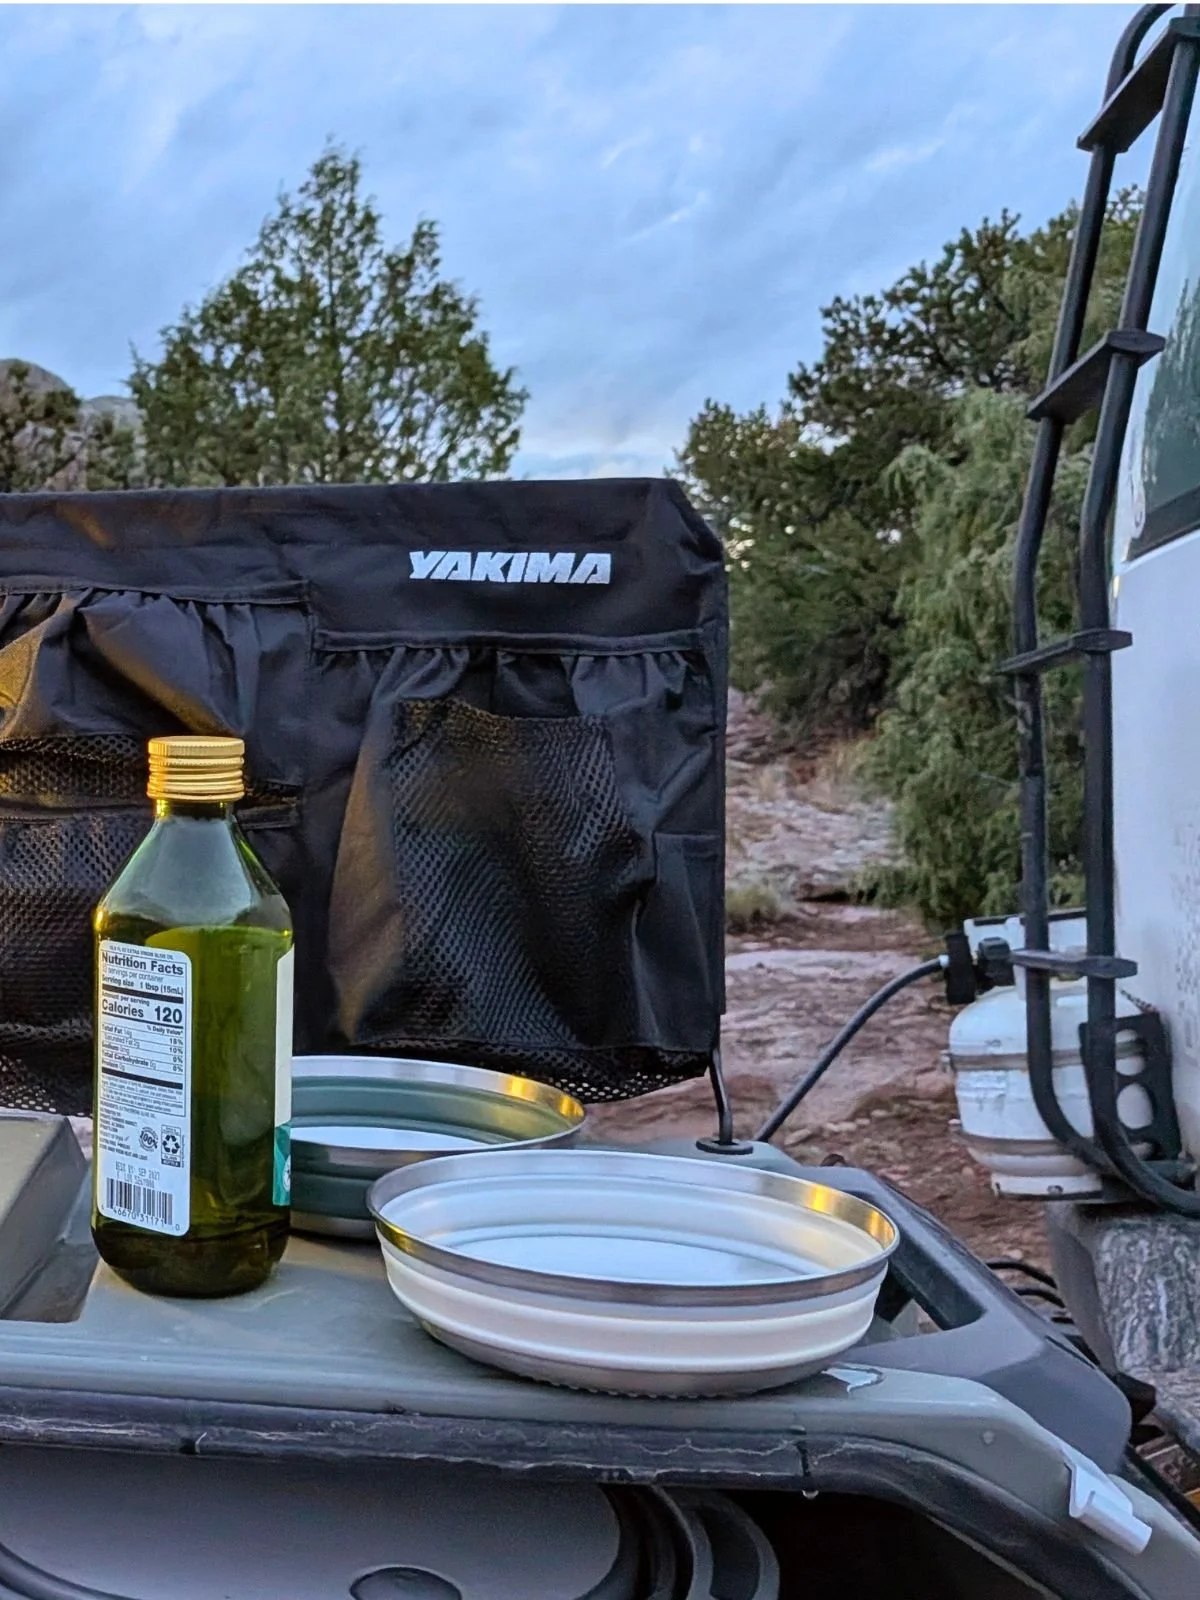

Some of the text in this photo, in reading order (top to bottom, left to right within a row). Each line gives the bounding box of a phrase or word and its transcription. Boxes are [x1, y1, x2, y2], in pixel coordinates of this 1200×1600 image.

[409, 550, 612, 585] YAKIMA
[102, 952, 184, 976] Nutrition Facts
[102, 975, 121, 986] Serving
[123, 978, 134, 987] size
[145, 982, 159, 992] tbsp
[160, 984, 184, 996] (15mL)
[129, 971, 138, 979] per
[139, 972, 164, 983] container
[120, 994, 129, 1002] per
[130, 996, 150, 1007] serving
[102, 999, 183, 1024] Calories 120
[140, 1130, 158, 1149] 100%
